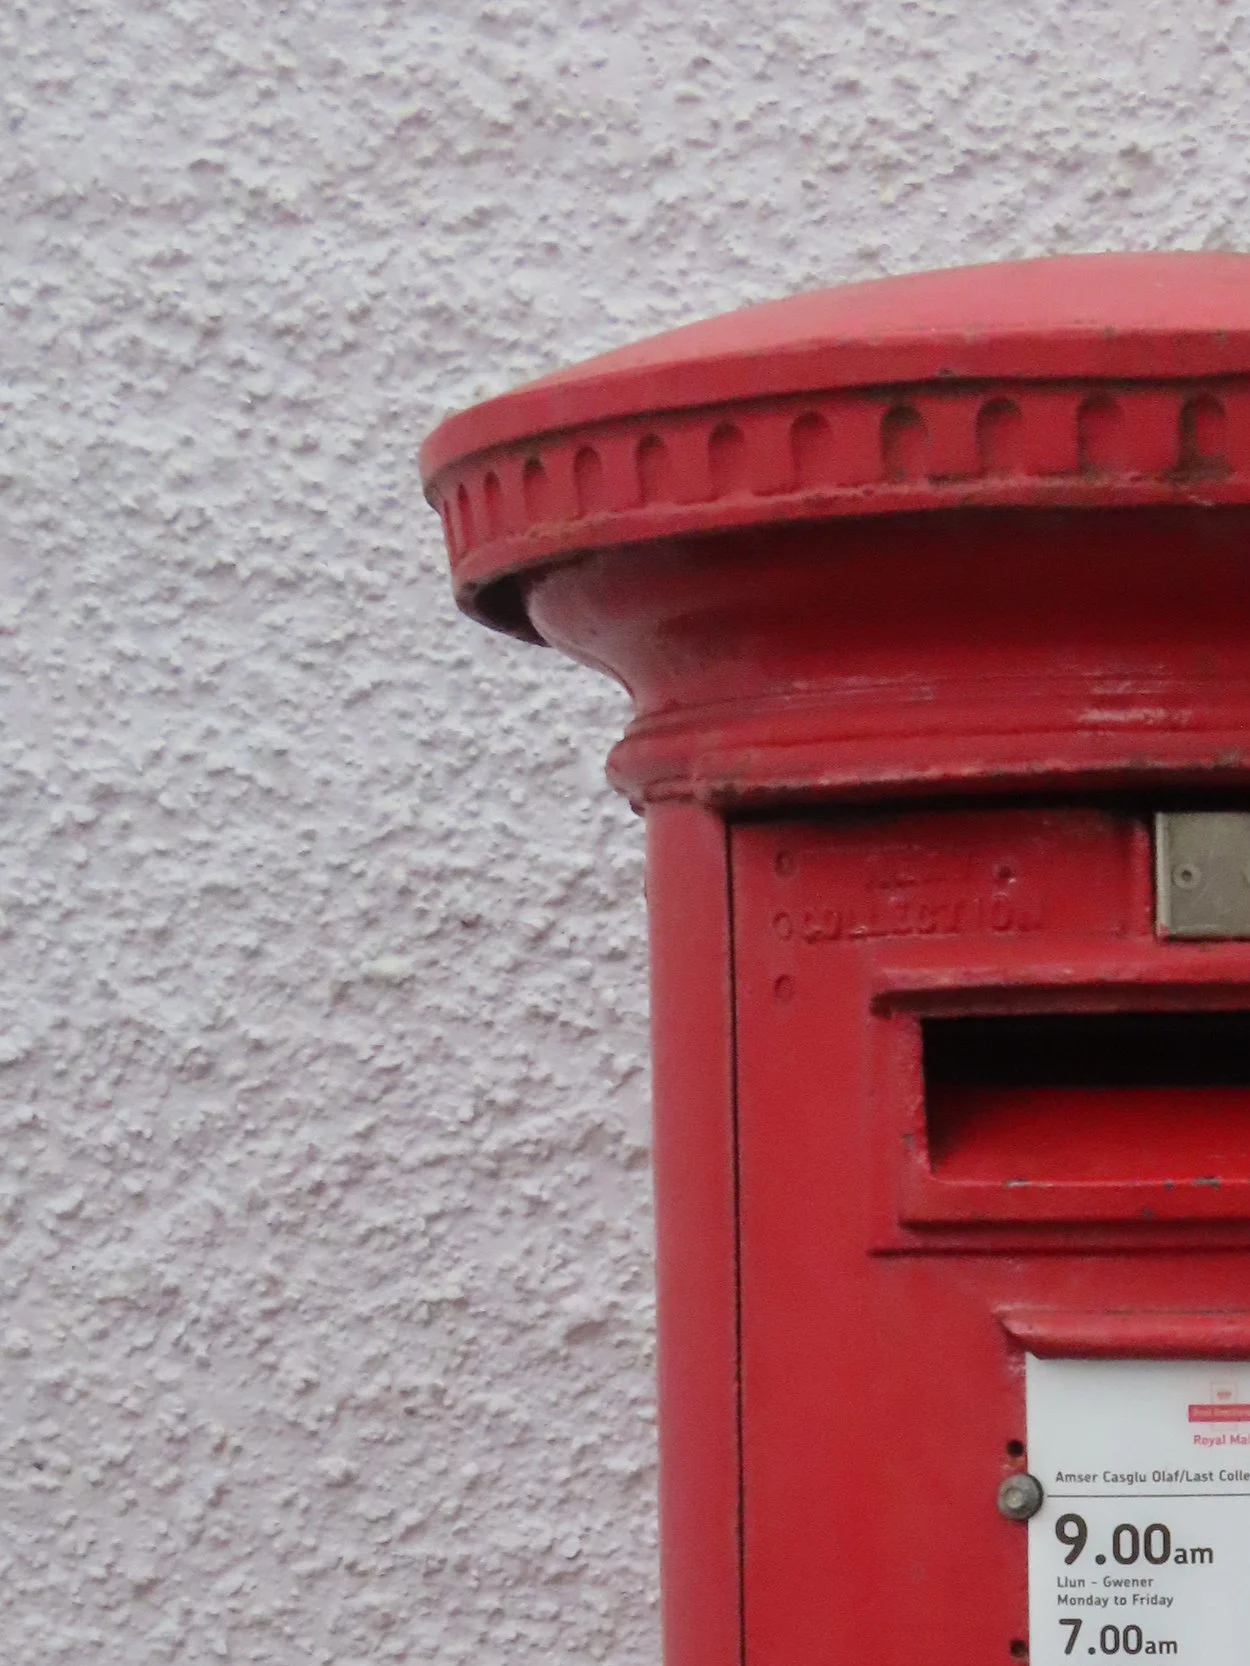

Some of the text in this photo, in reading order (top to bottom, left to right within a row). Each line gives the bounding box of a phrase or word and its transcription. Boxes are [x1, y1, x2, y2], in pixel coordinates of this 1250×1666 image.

[1193, 1434, 1225, 1447] Royal
[1055, 1471, 1099, 1484] Amser
[1103, 1470, 1147, 1485] Casglu
[1152, 1469, 1214, 1483] Olaf/Last
[1055, 1512, 1214, 1565] 9.00am
[1057, 1576, 1086, 1588] Llun
[1103, 1575, 1154, 1588] Gwener
[1057, 1594, 1174, 1608] Monday to Friday
[1058, 1618, 1178, 1655] 7.00am
